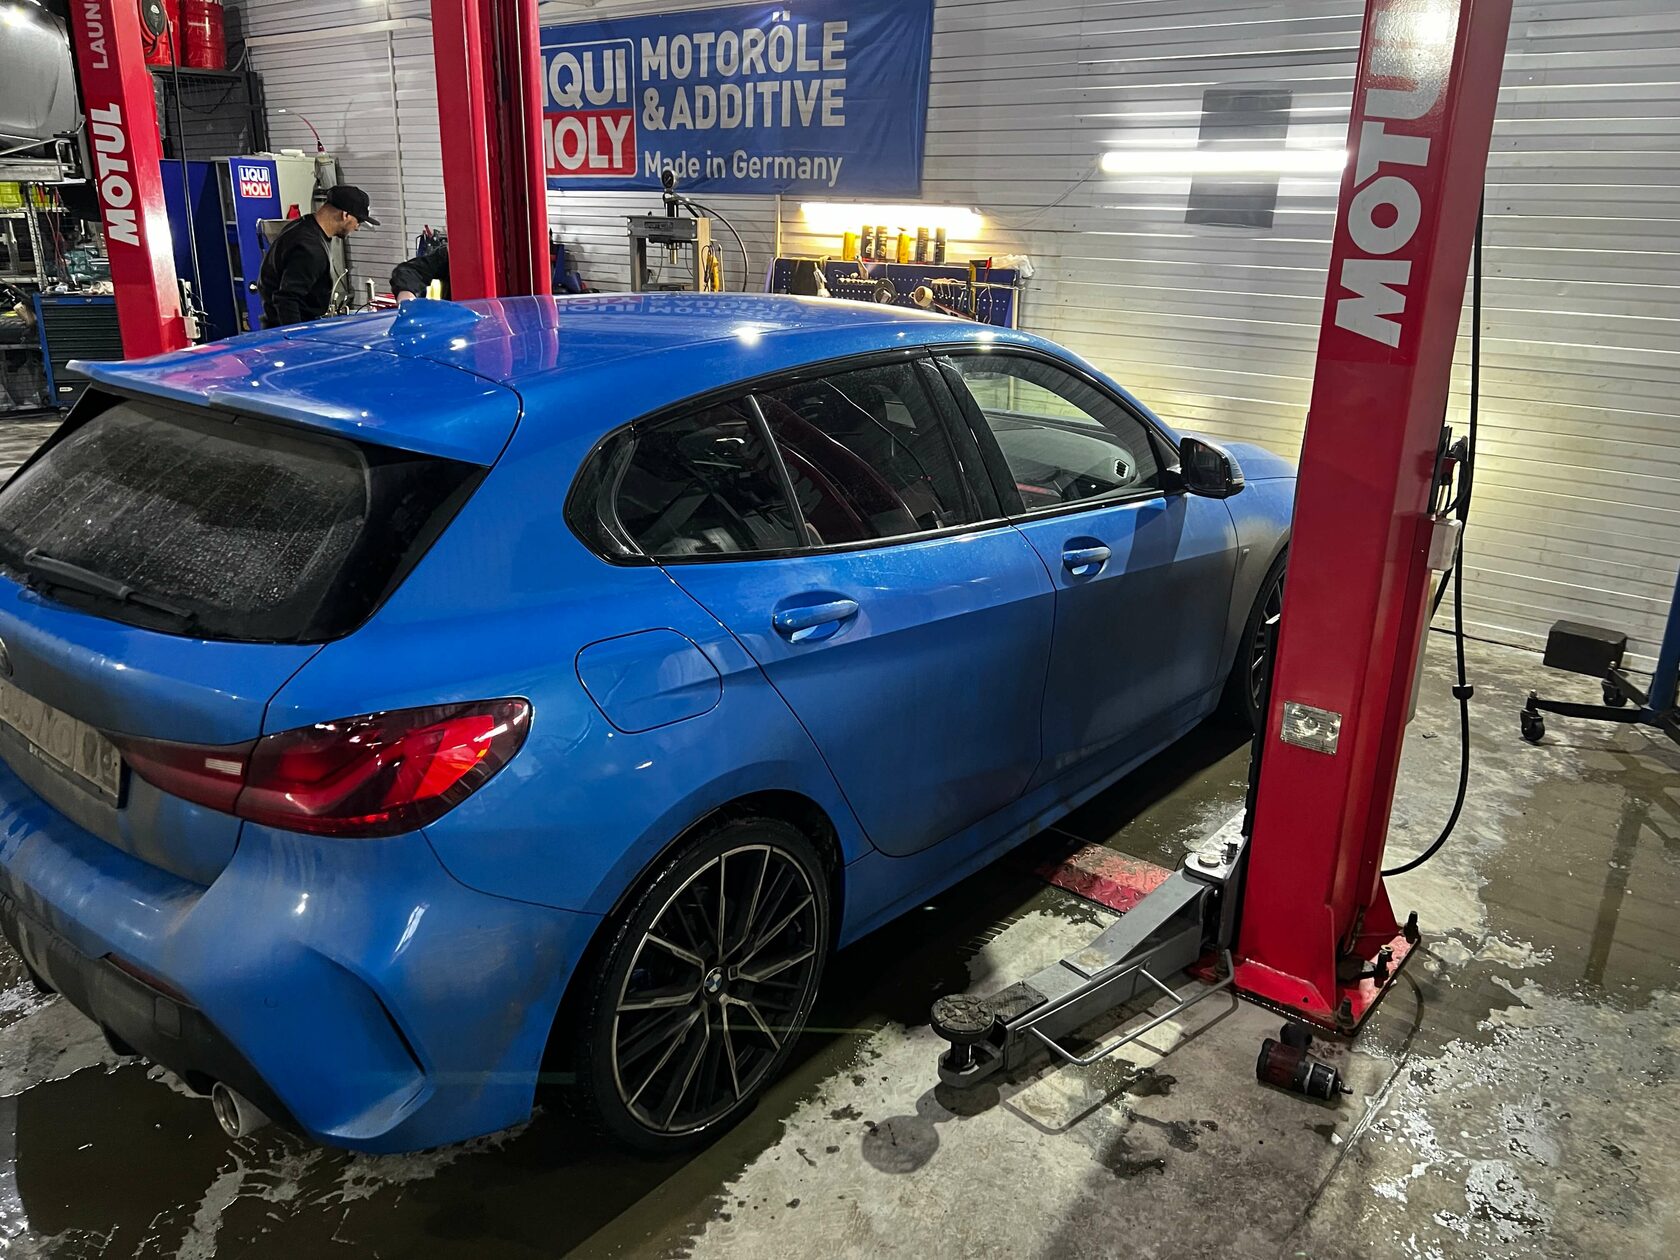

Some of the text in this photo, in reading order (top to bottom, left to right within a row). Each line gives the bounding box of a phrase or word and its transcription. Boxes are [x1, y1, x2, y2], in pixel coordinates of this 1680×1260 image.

[84, 0, 109, 69] LAUN
[641, 10, 848, 81] MOTORÖLE
[541, 48, 627, 110] IQUI
[90, 102, 140, 247] MOTUL
[240, 167, 269, 182] LIQUI
[242, 182, 270, 196] MOLY
[644, 149, 843, 188] Made in Germany
